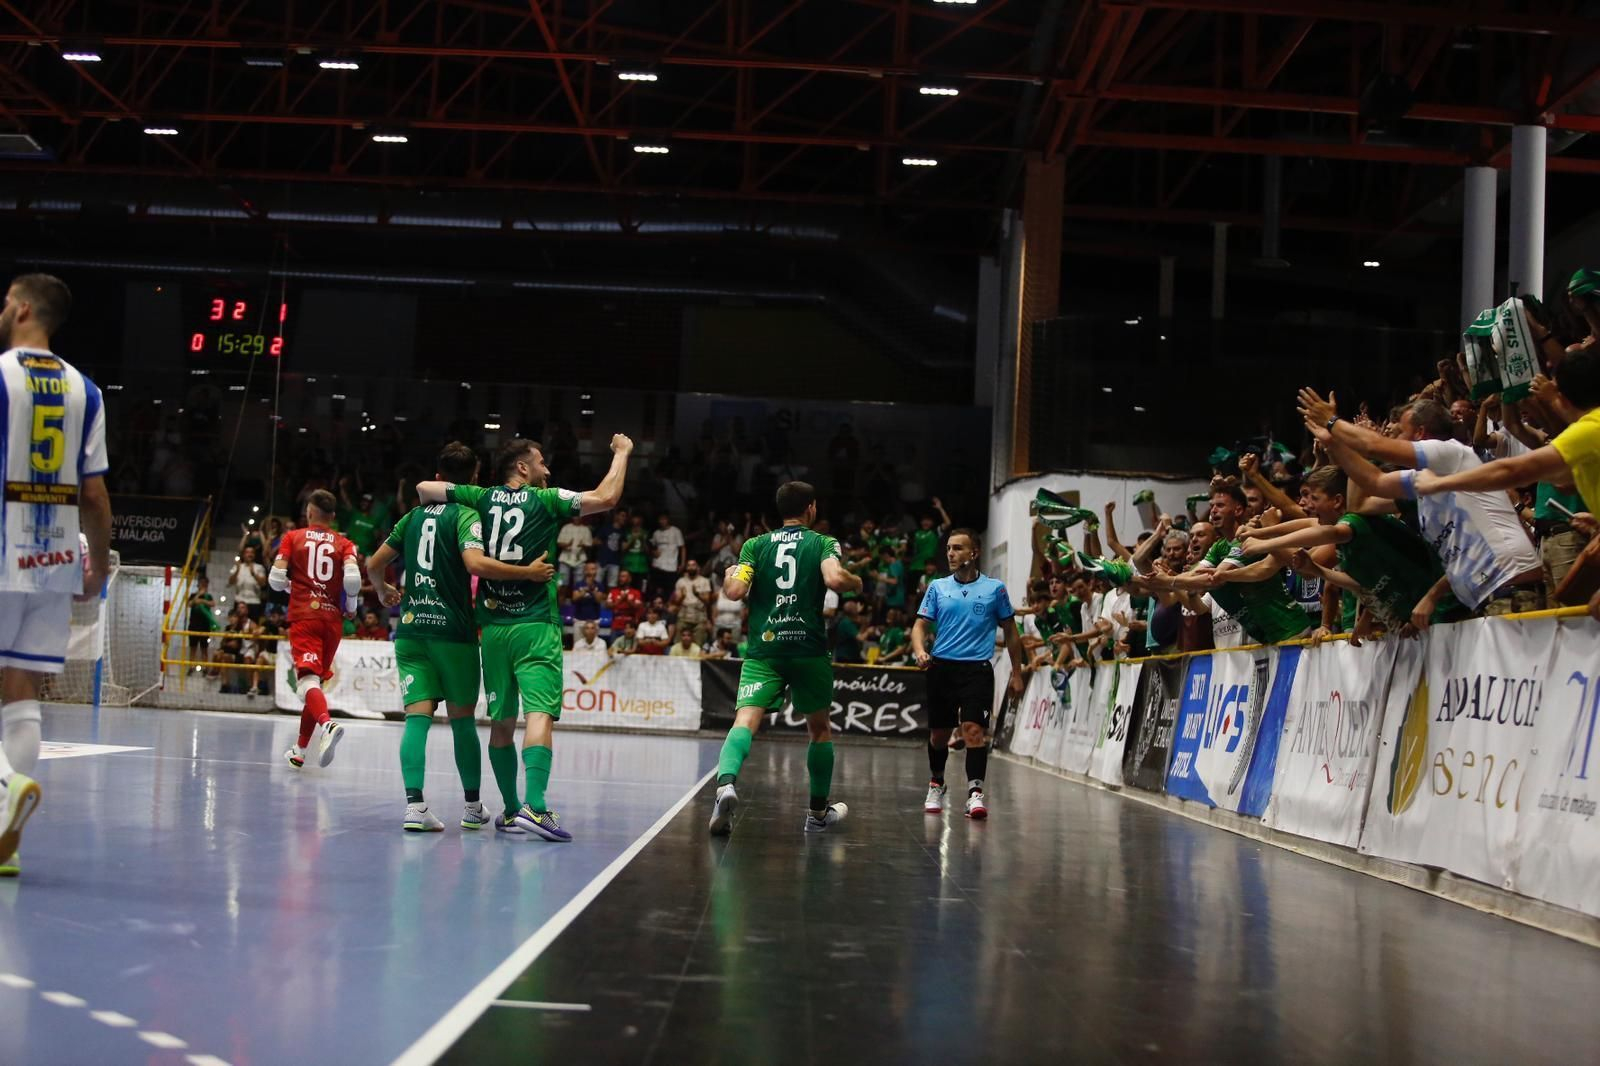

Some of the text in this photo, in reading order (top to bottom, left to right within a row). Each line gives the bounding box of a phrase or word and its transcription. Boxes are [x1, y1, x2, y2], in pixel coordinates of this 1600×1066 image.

[210, 299, 287, 322] 3 2 1
[191, 333, 284, 355] 0 15:29 2
[31, 405, 65, 473] 5
[111, 515, 178, 529] NIVERSIDAD
[488, 506, 525, 561] 12
[771, 530, 804, 542] MIGUEL
[417, 518, 437, 571] 8
[304, 541, 335, 582] 16
[775, 542, 797, 589] 5
[619, 697, 675, 721] viajes
